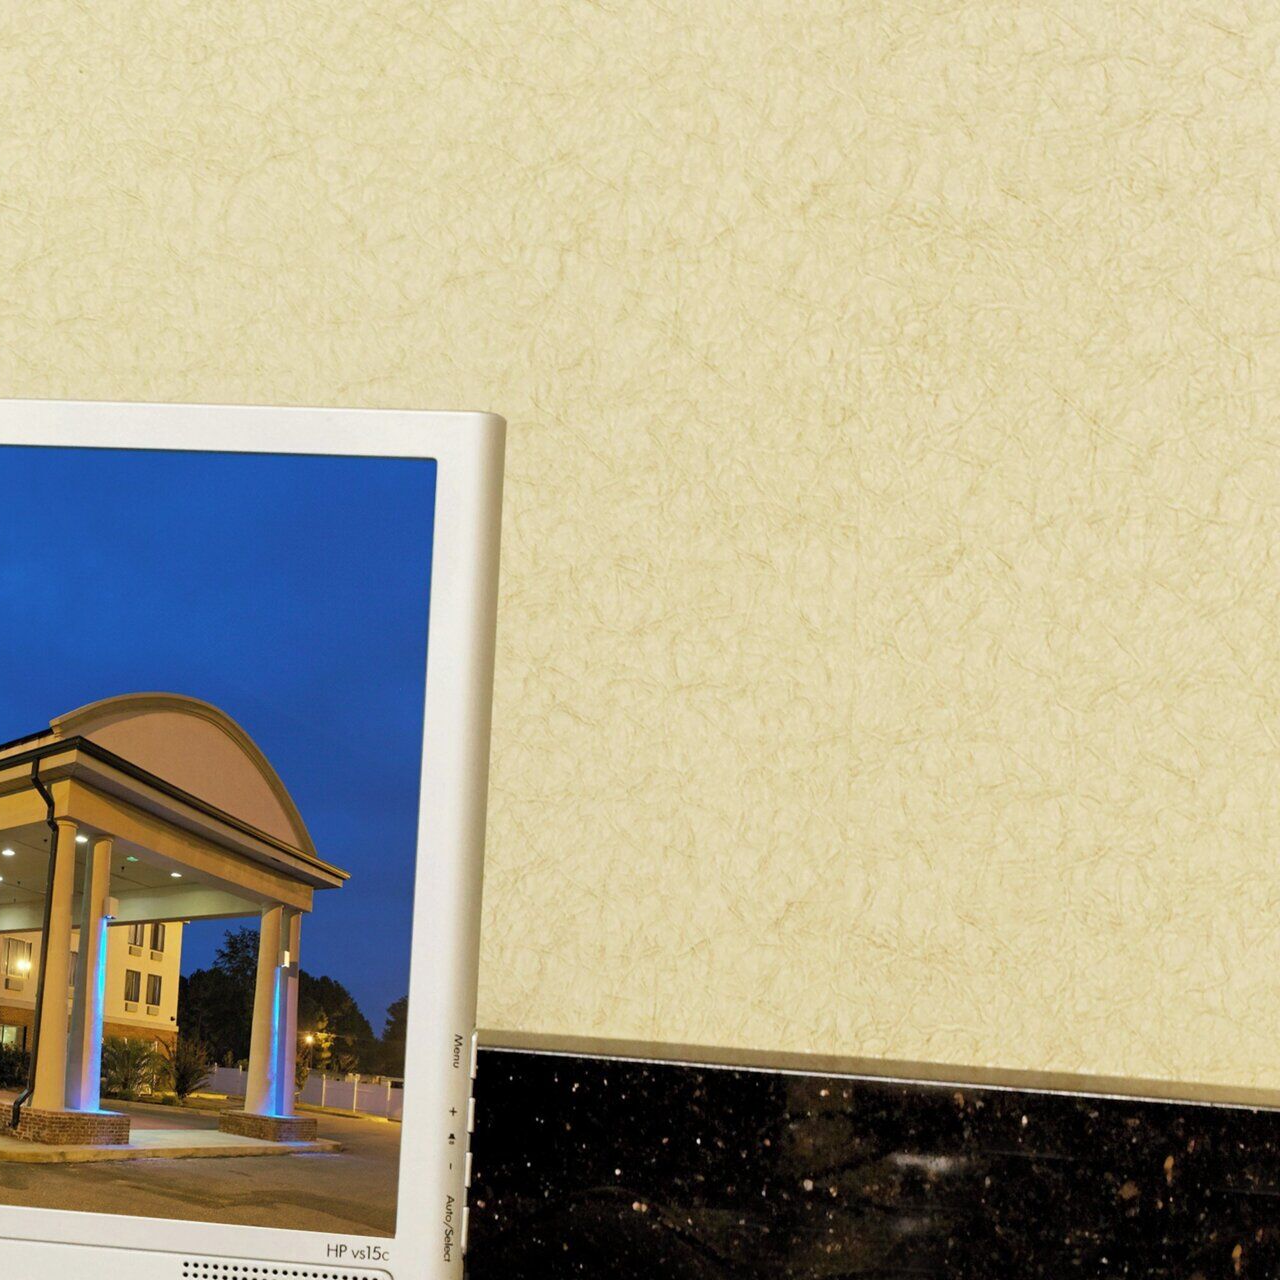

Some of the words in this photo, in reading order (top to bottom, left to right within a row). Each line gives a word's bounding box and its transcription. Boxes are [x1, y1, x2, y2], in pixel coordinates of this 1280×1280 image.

[453, 1034, 464, 1069] Menu
[443, 1195, 455, 1263] Auto/Select
[327, 1244, 348, 1259] HP
[351, 1246, 390, 1262] vs15c
